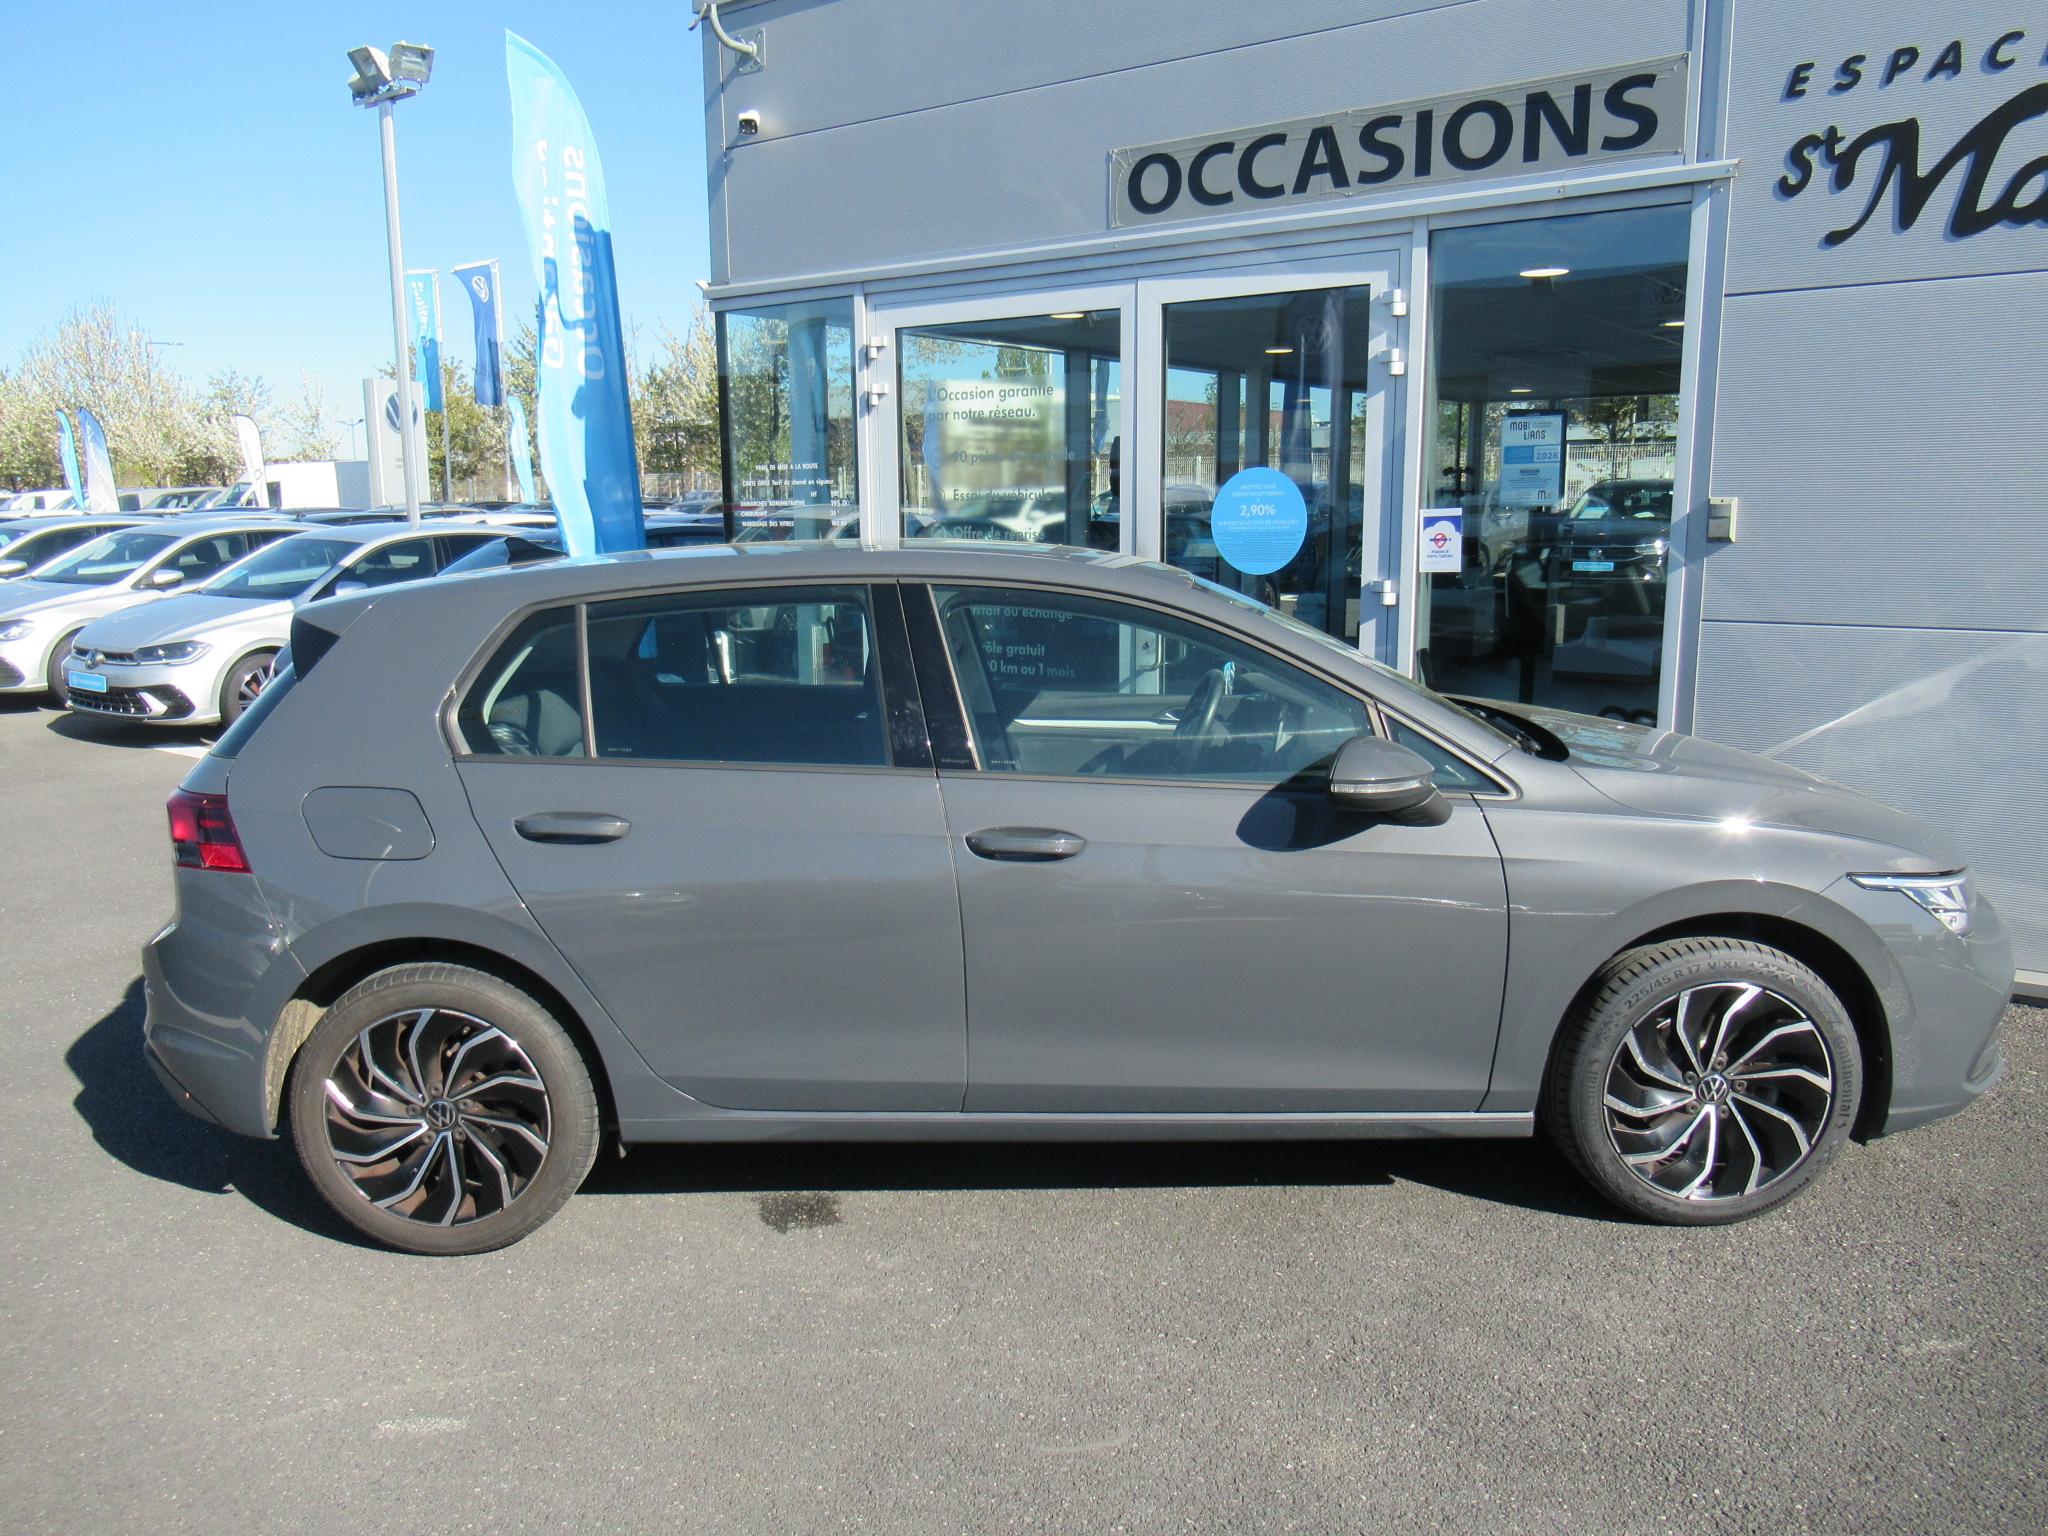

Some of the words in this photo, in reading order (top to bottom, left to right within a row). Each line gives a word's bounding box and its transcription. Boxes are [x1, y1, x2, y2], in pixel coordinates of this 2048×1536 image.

[1784, 29, 2048, 101] ESPAC
[1128, 73, 1659, 214] OCCASIONS
[928, 386, 994, 402] L'Occasion
[998, 384, 1054, 400] garantie
[928, 410, 949, 423] par
[953, 406, 984, 420] notre
[988, 405, 1036, 419] réseau.
[1240, 504, 1276, 518] 2,90%
[953, 525, 983, 539] Offre
[1006, 643, 1045, 657] gratuit
[1000, 660, 1018, 674] km
[1021, 665, 1035, 675] ou
[1046, 665, 1075, 678] mois
[1623, 974, 1673, 1010] 225/45
